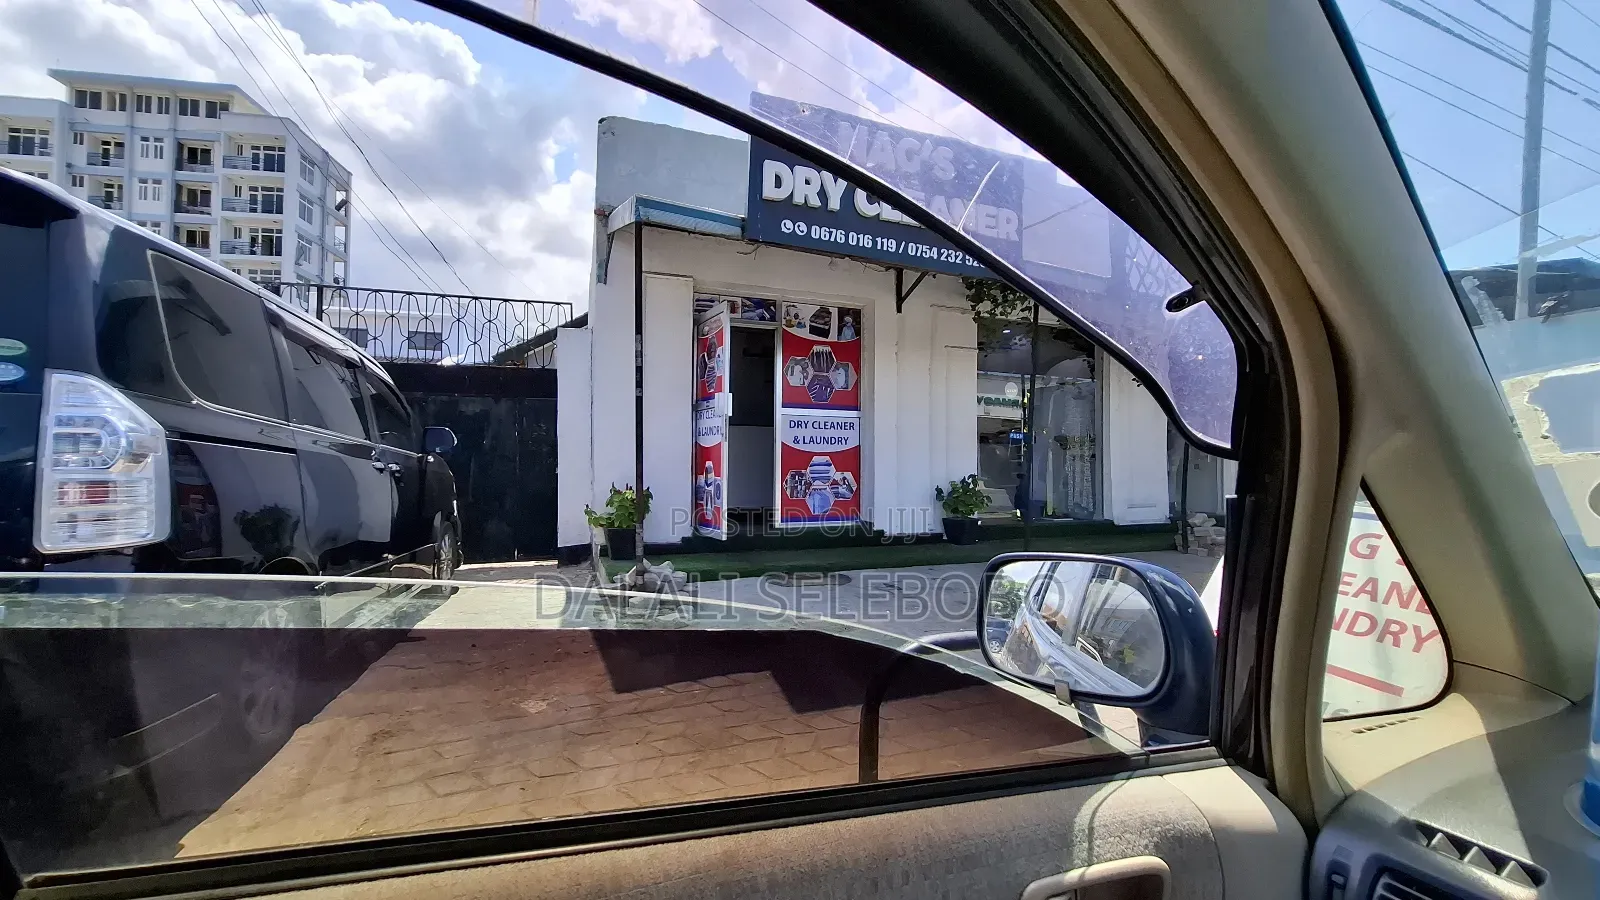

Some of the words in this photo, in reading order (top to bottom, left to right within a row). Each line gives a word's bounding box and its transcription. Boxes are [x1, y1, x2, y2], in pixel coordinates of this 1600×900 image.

[762, 159, 848, 212] DRY
[811, 224, 846, 244] 0676
[848, 234, 873, 248] 016
[875, 237, 896, 252] 119
[899, 241, 905, 254] /
[908, 242, 937, 260] 0754
[940, 248, 963, 264] 232
[965, 254, 985, 268] 52
[789, 420, 809, 429] DRY
[811, 420, 855, 431] CLEANER
[792, 435, 800, 445] &
[802, 435, 849, 446] LAUNDRY
